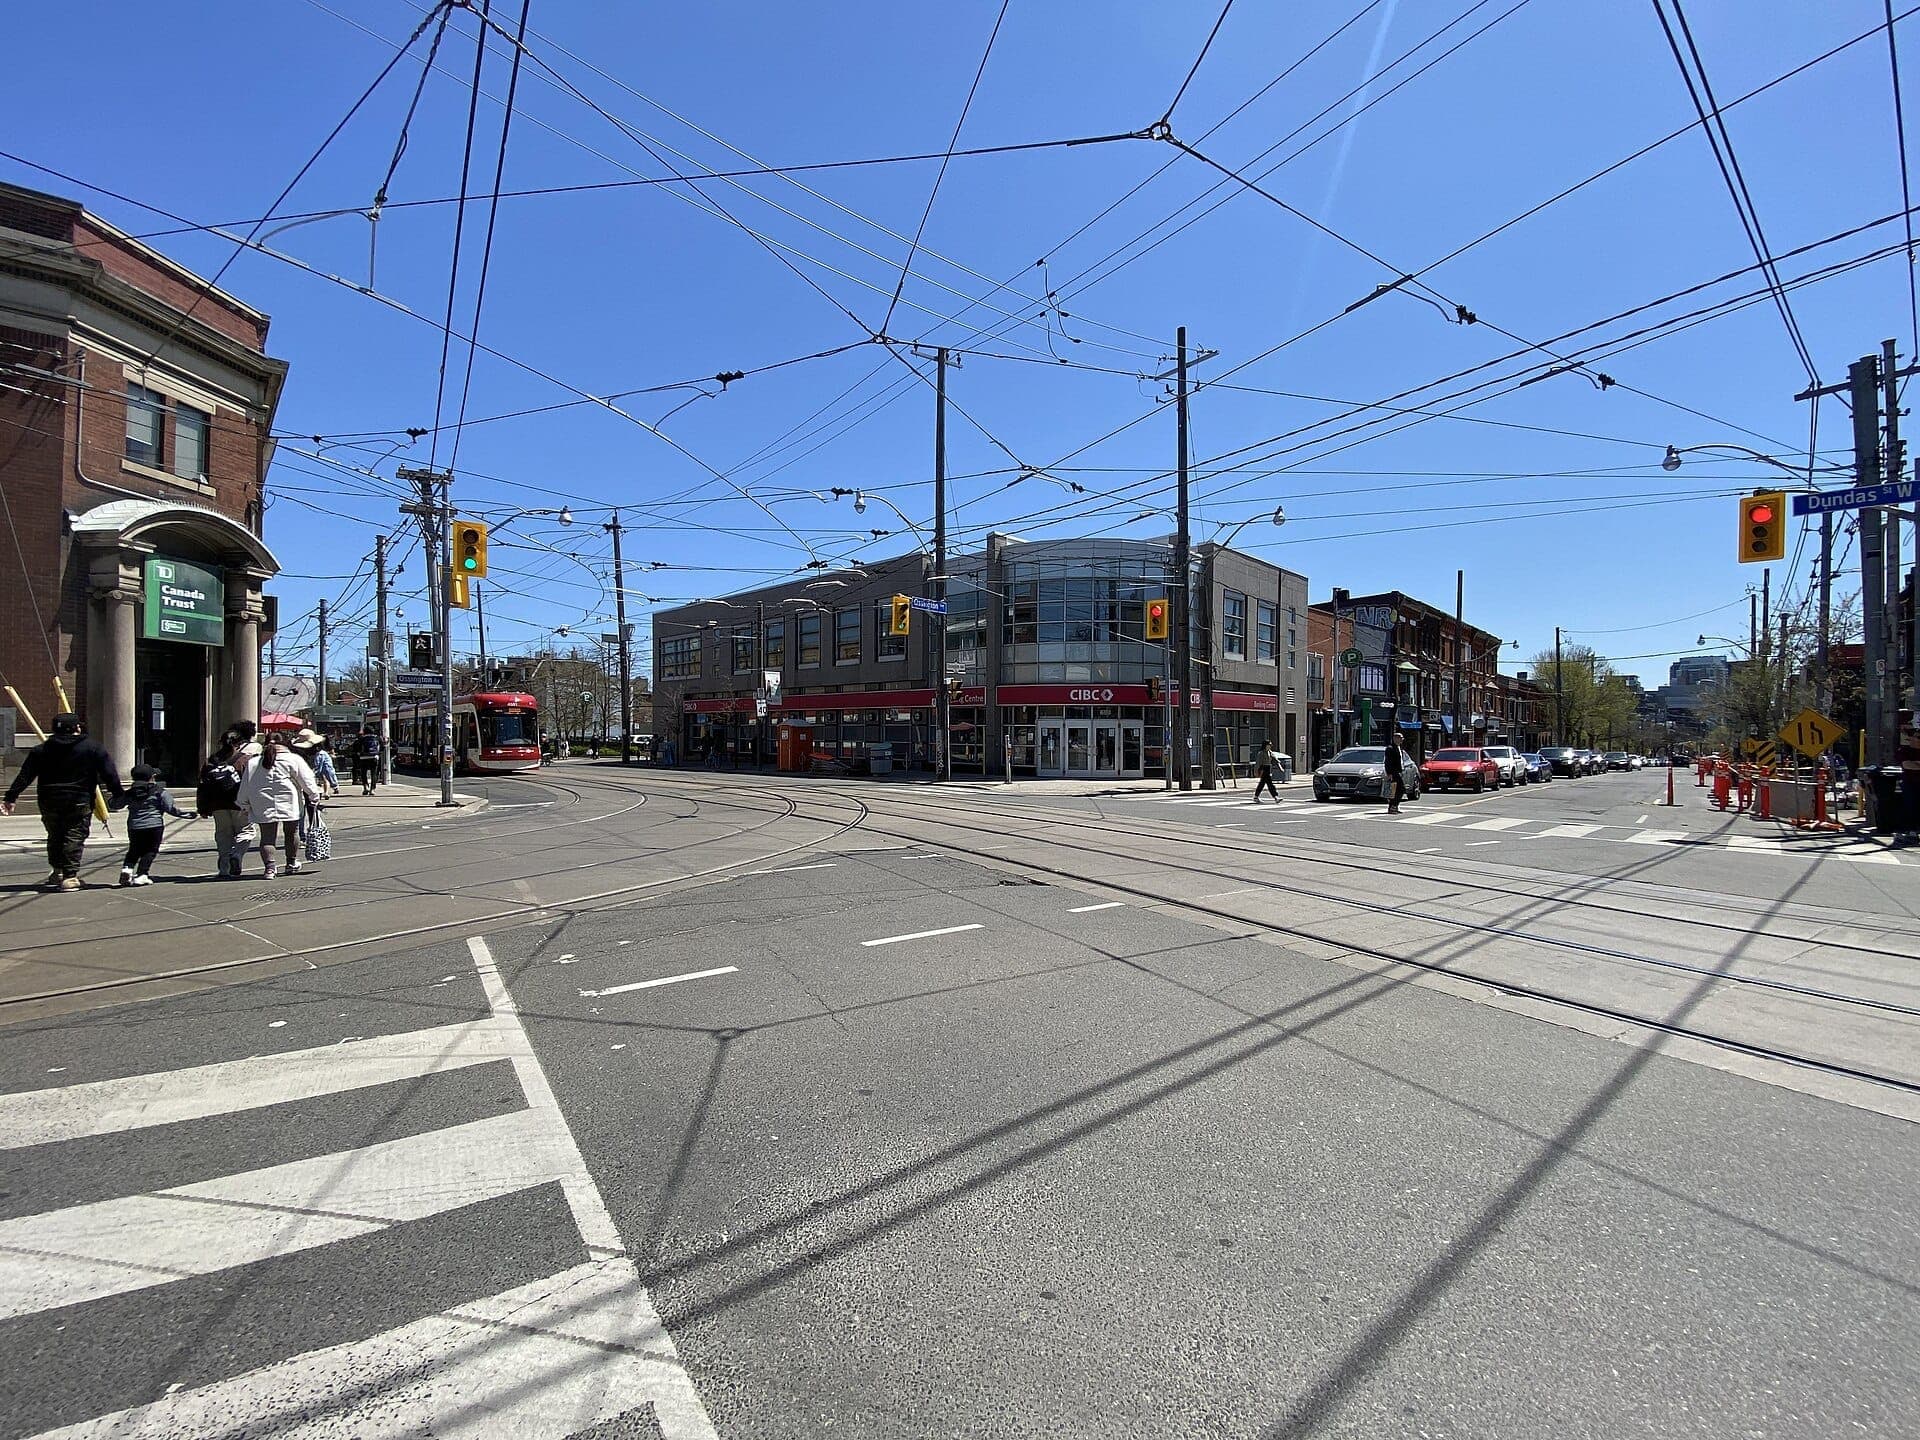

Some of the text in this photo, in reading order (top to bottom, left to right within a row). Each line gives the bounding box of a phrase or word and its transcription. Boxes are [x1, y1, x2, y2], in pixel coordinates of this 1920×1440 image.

[1808, 483, 1912, 509] Dundas St W
[156, 565, 173, 579] TD
[161, 585, 205, 600] Canada
[161, 596, 195, 610] Trust
[1348, 653, 1356, 662] P
[964, 694, 983, 703] Centre
[1070, 689, 1100, 700] CIBC
[1190, 693, 1200, 704] CIB
[758, 706, 767, 714] 40
